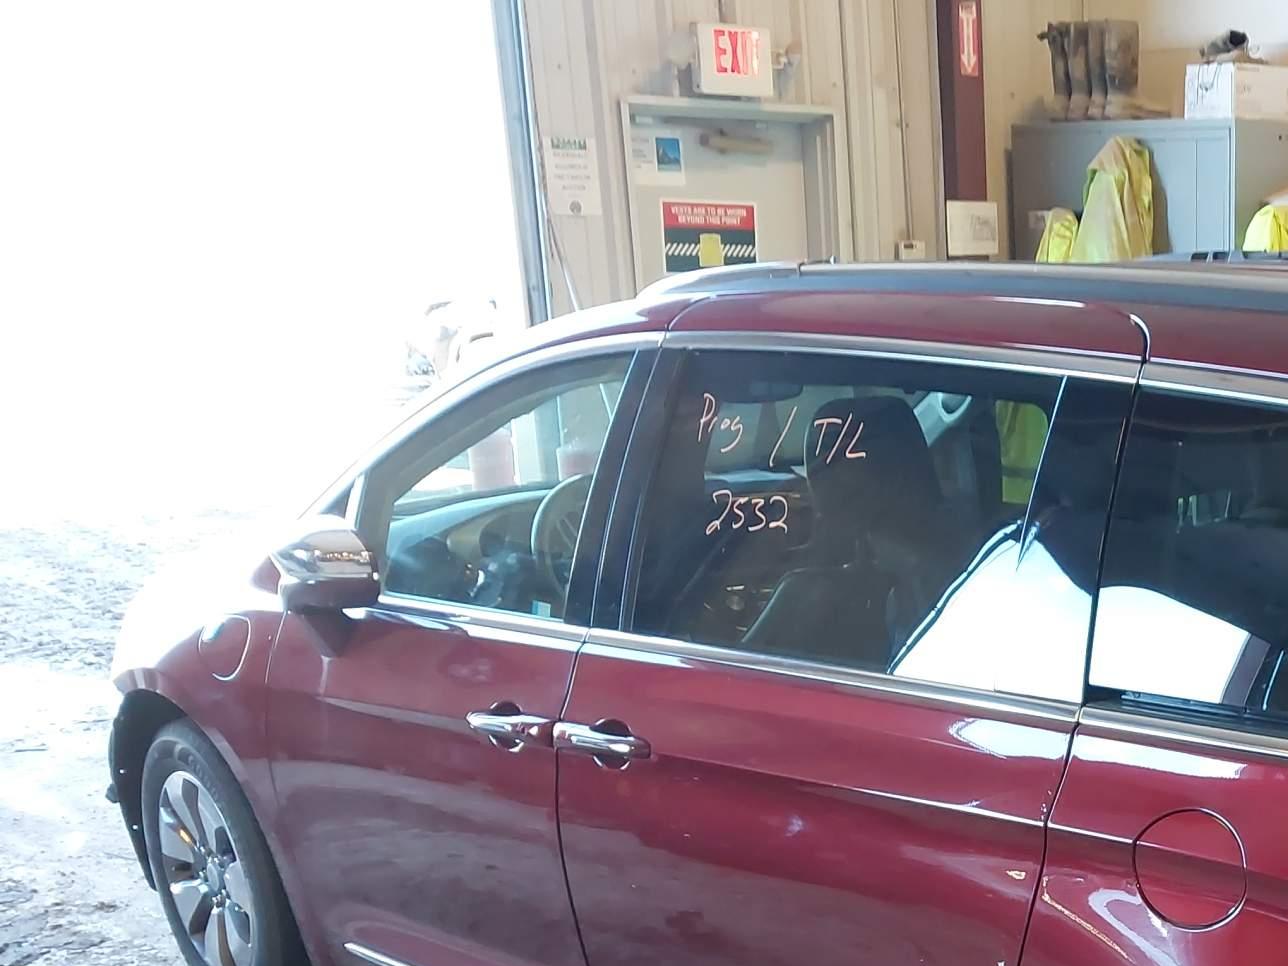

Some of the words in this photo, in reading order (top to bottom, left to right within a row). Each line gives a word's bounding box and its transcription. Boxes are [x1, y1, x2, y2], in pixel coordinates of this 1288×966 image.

[713, 29, 761, 77] EXIT
[671, 205, 692, 215] VESTS
[693, 206, 706, 215] ARE
[707, 207, 716, 215] TO
[717, 207, 725, 216] BE
[677, 215, 705, 224] BEYOND
[705, 488, 789, 536] 2532
